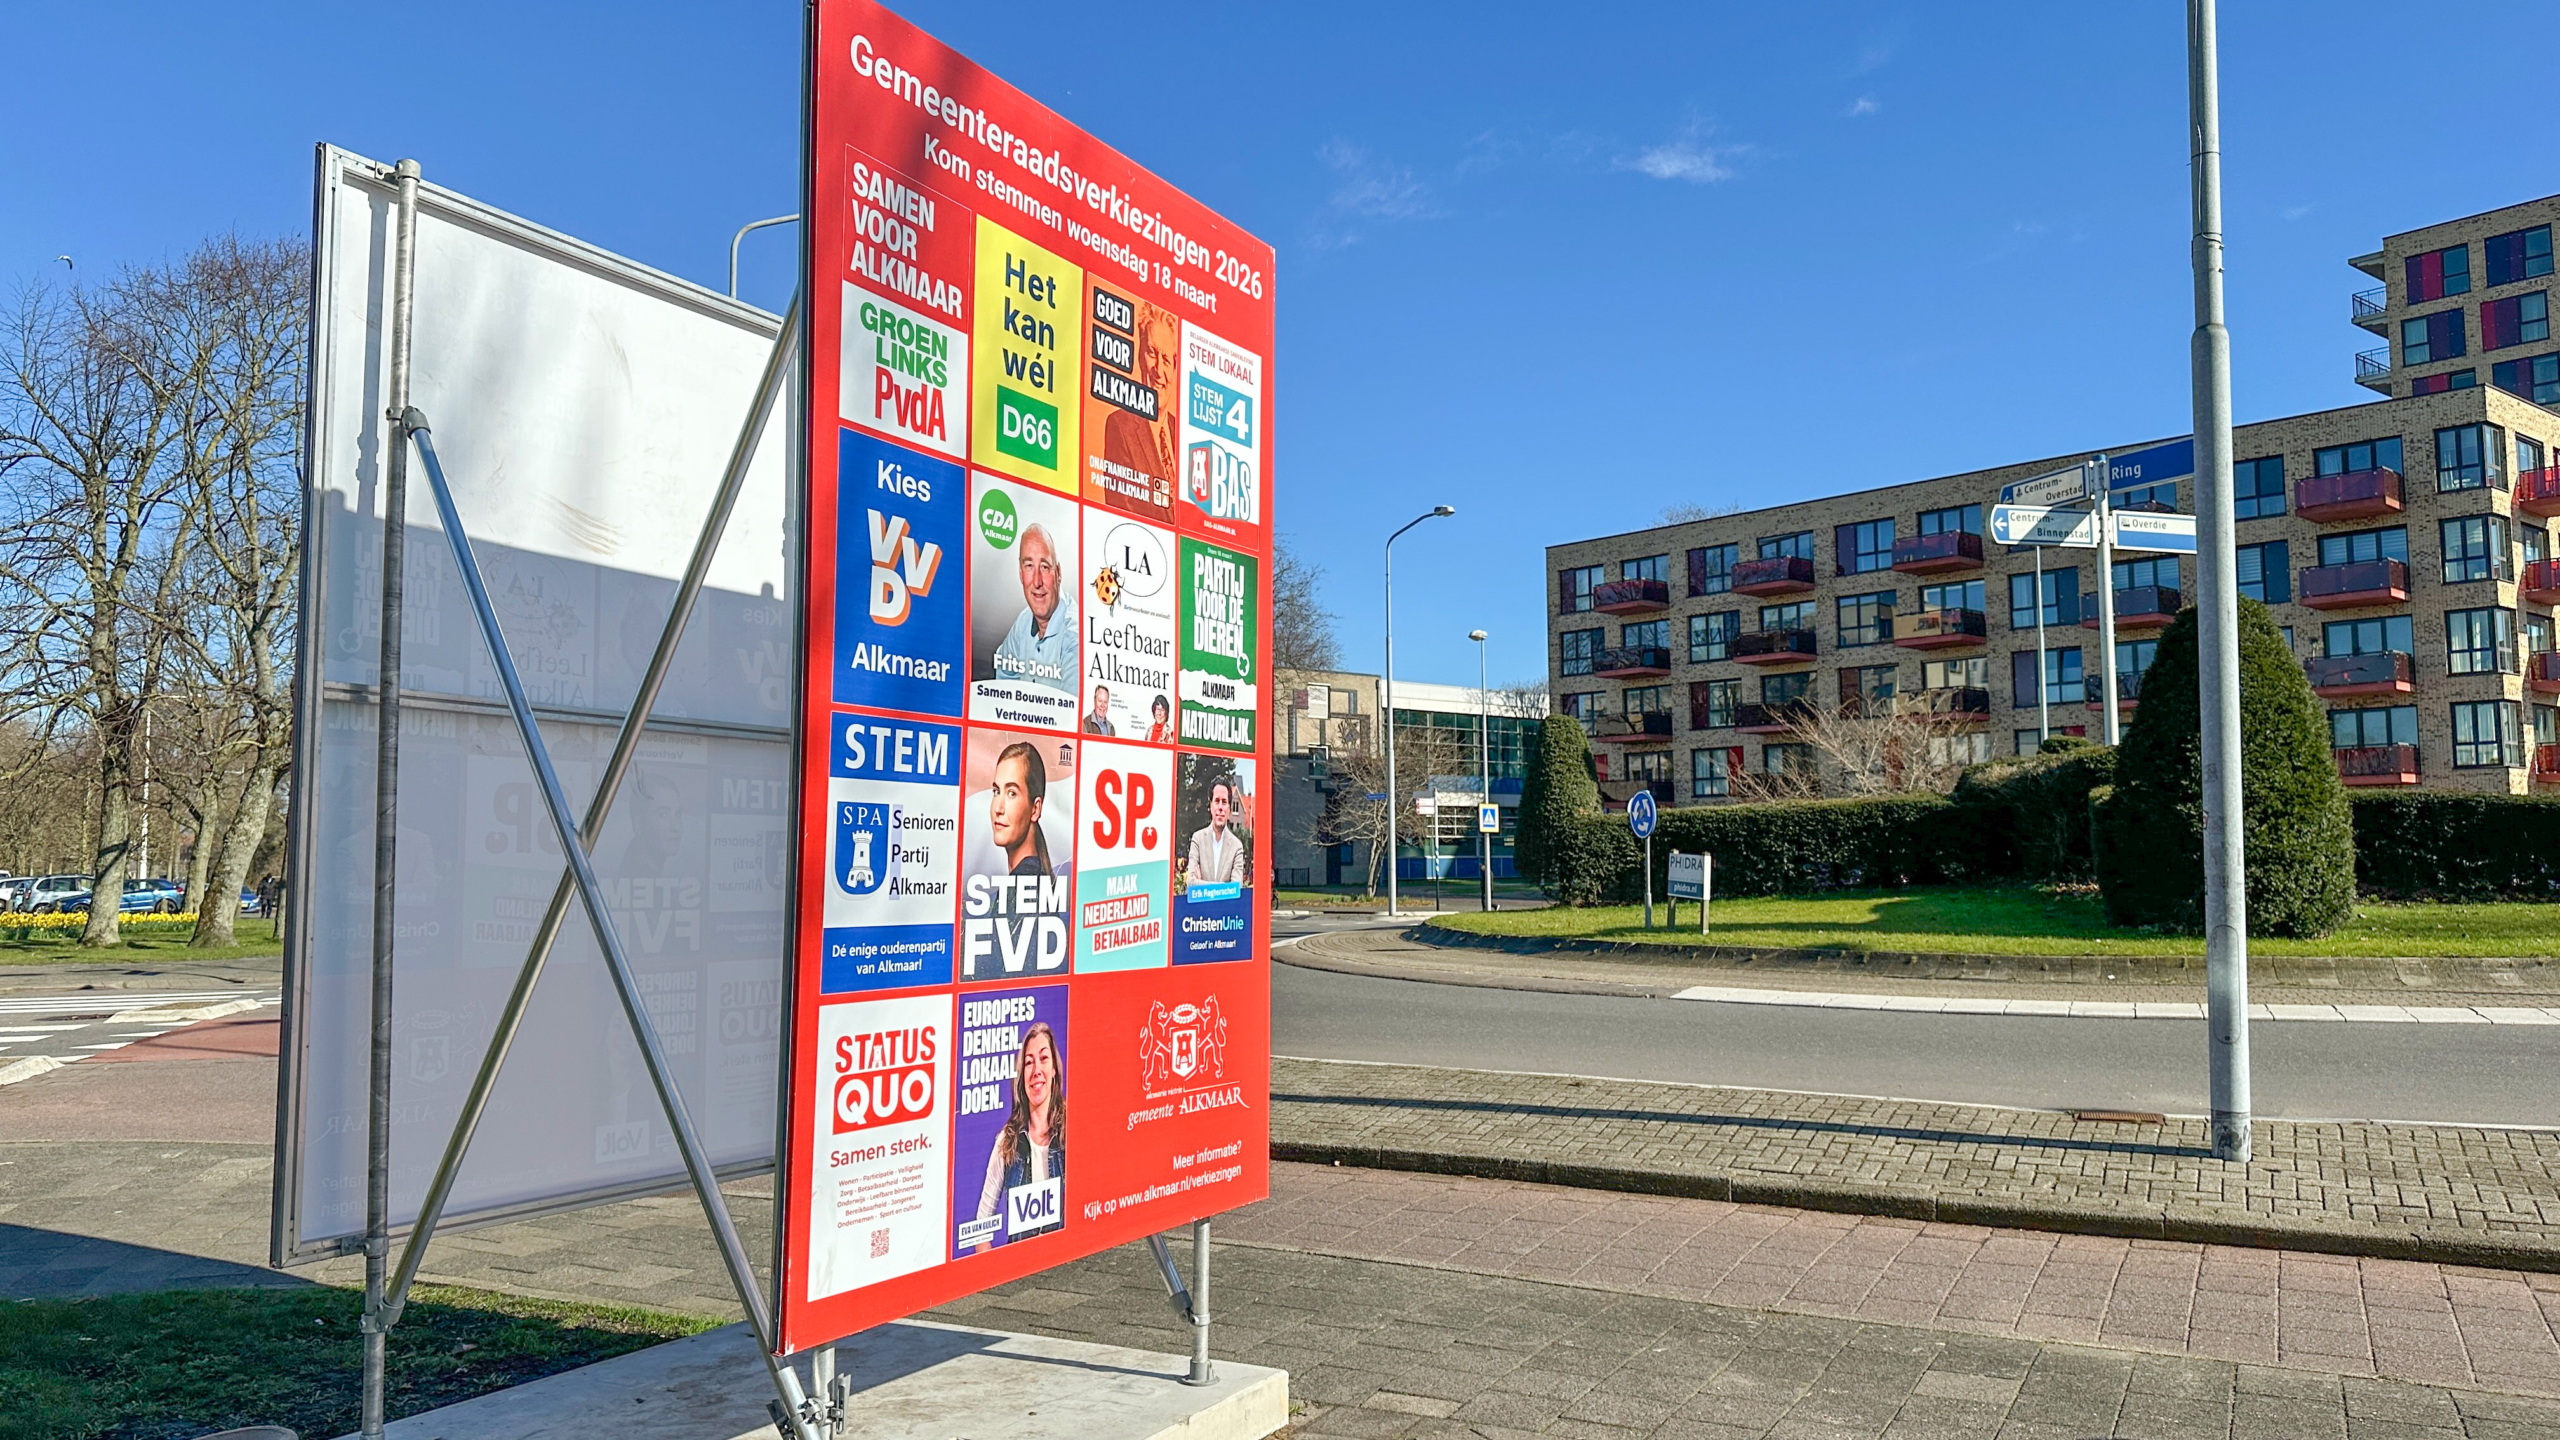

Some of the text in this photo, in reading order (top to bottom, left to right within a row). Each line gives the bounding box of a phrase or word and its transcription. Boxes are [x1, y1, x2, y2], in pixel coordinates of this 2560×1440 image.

[850, 34, 1263, 300] Gemeenteraadsverkiezingen 2026
[852, 162, 935, 232] SAMEN
[851, 199, 917, 261] VOOR
[924, 133, 1217, 313] Kom stemmen woensdag 18 maart
[850, 246, 962, 319] ALKMAAR
[1005, 251, 1056, 309] Het
[1003, 296, 1054, 351] kan
[1096, 293, 1130, 329] GOED
[860, 302, 948, 361] GROEN
[1095, 330, 1130, 368] VOOR
[876, 336, 948, 388] LINKS
[1002, 347, 1053, 393] wél
[1189, 343, 1253, 386] STEM LOKAAL
[875, 365, 946, 442] PvdA
[1093, 370, 1154, 416] ALKMAAR
[1194, 383, 1223, 408] STEM
[1002, 403, 1052, 450] D66
[1194, 398, 1249, 440] LIJST 4
[877, 459, 931, 502] Kies
[1089, 454, 1149, 487] ONAFHANKELIJKE
[1091, 471, 1116, 492] PARTIJ
[1117, 480, 1149, 503] ALKMAAR
[1211, 440, 1250, 522] BAS
[2024, 478, 2062, 494] Centrum-
[2112, 464, 2141, 480] Ring
[2046, 484, 2083, 501] Overstad
[982, 508, 1014, 532] CDA
[2010, 512, 2054, 523] Centrum-
[2037, 528, 2089, 538] Binnenstad
[2132, 519, 2167, 529] Overdie
[984, 529, 1012, 543] Alkmaar
[1123, 545, 1152, 576] LA
[1194, 552, 1244, 599] PARTIJ
[1194, 587, 1243, 626] VOOR DE
[1088, 615, 1170, 658] Leefbaar
[1194, 615, 1243, 659] DIEREN
[851, 642, 950, 682] Alkmaar
[993, 653, 1062, 680] Frits Jonk
[1088, 651, 1169, 691] Alkmaar
[977, 684, 1075, 709] Samen Bouwen aan
[1202, 680, 1235, 702] ALKMAAR
[995, 707, 1057, 726] Vertrouwen.
[1181, 708, 1252, 746] NATUURLIJK.
[844, 723, 949, 776] STEM
[892, 809, 954, 831] Senioren
[891, 844, 929, 868] Partij
[889, 876, 948, 896] Alkmaar
[965, 873, 1068, 917] STEM
[1106, 873, 1138, 897] MAAK
[1673, 883, 1698, 893] phidra.nl
[1084, 897, 1148, 926] NEDERLAND
[1182, 915, 1244, 933] ChristenUnie
[832, 939, 946, 959] Dé enige ouderenpartij
[963, 916, 1067, 976] FVD
[1094, 921, 1160, 951] BETAALBAAR
[856, 958, 922, 975] van Alkmaar!
[964, 996, 1035, 1028] EUROPEES
[835, 1026, 936, 1073] STATUS
[963, 1025, 1022, 1057] DENKEN.
[962, 1053, 1018, 1086] LOKAAL
[837, 1069, 931, 1125] QUO
[961, 1083, 1004, 1116] DOEN.
[1127, 1086, 1250, 1131] gemeente ALKMAAR
[830, 1133, 932, 1168] Samen sterk.
[1173, 1140, 1242, 1170] Meer informatie?
[839, 1178, 858, 1187] Wonen
[840, 1189, 853, 1197] Zorg
[1084, 1165, 1242, 1221] Kijk op www.alkmaar.nl/verkiezingen
[1015, 1188, 1055, 1223] Volt
